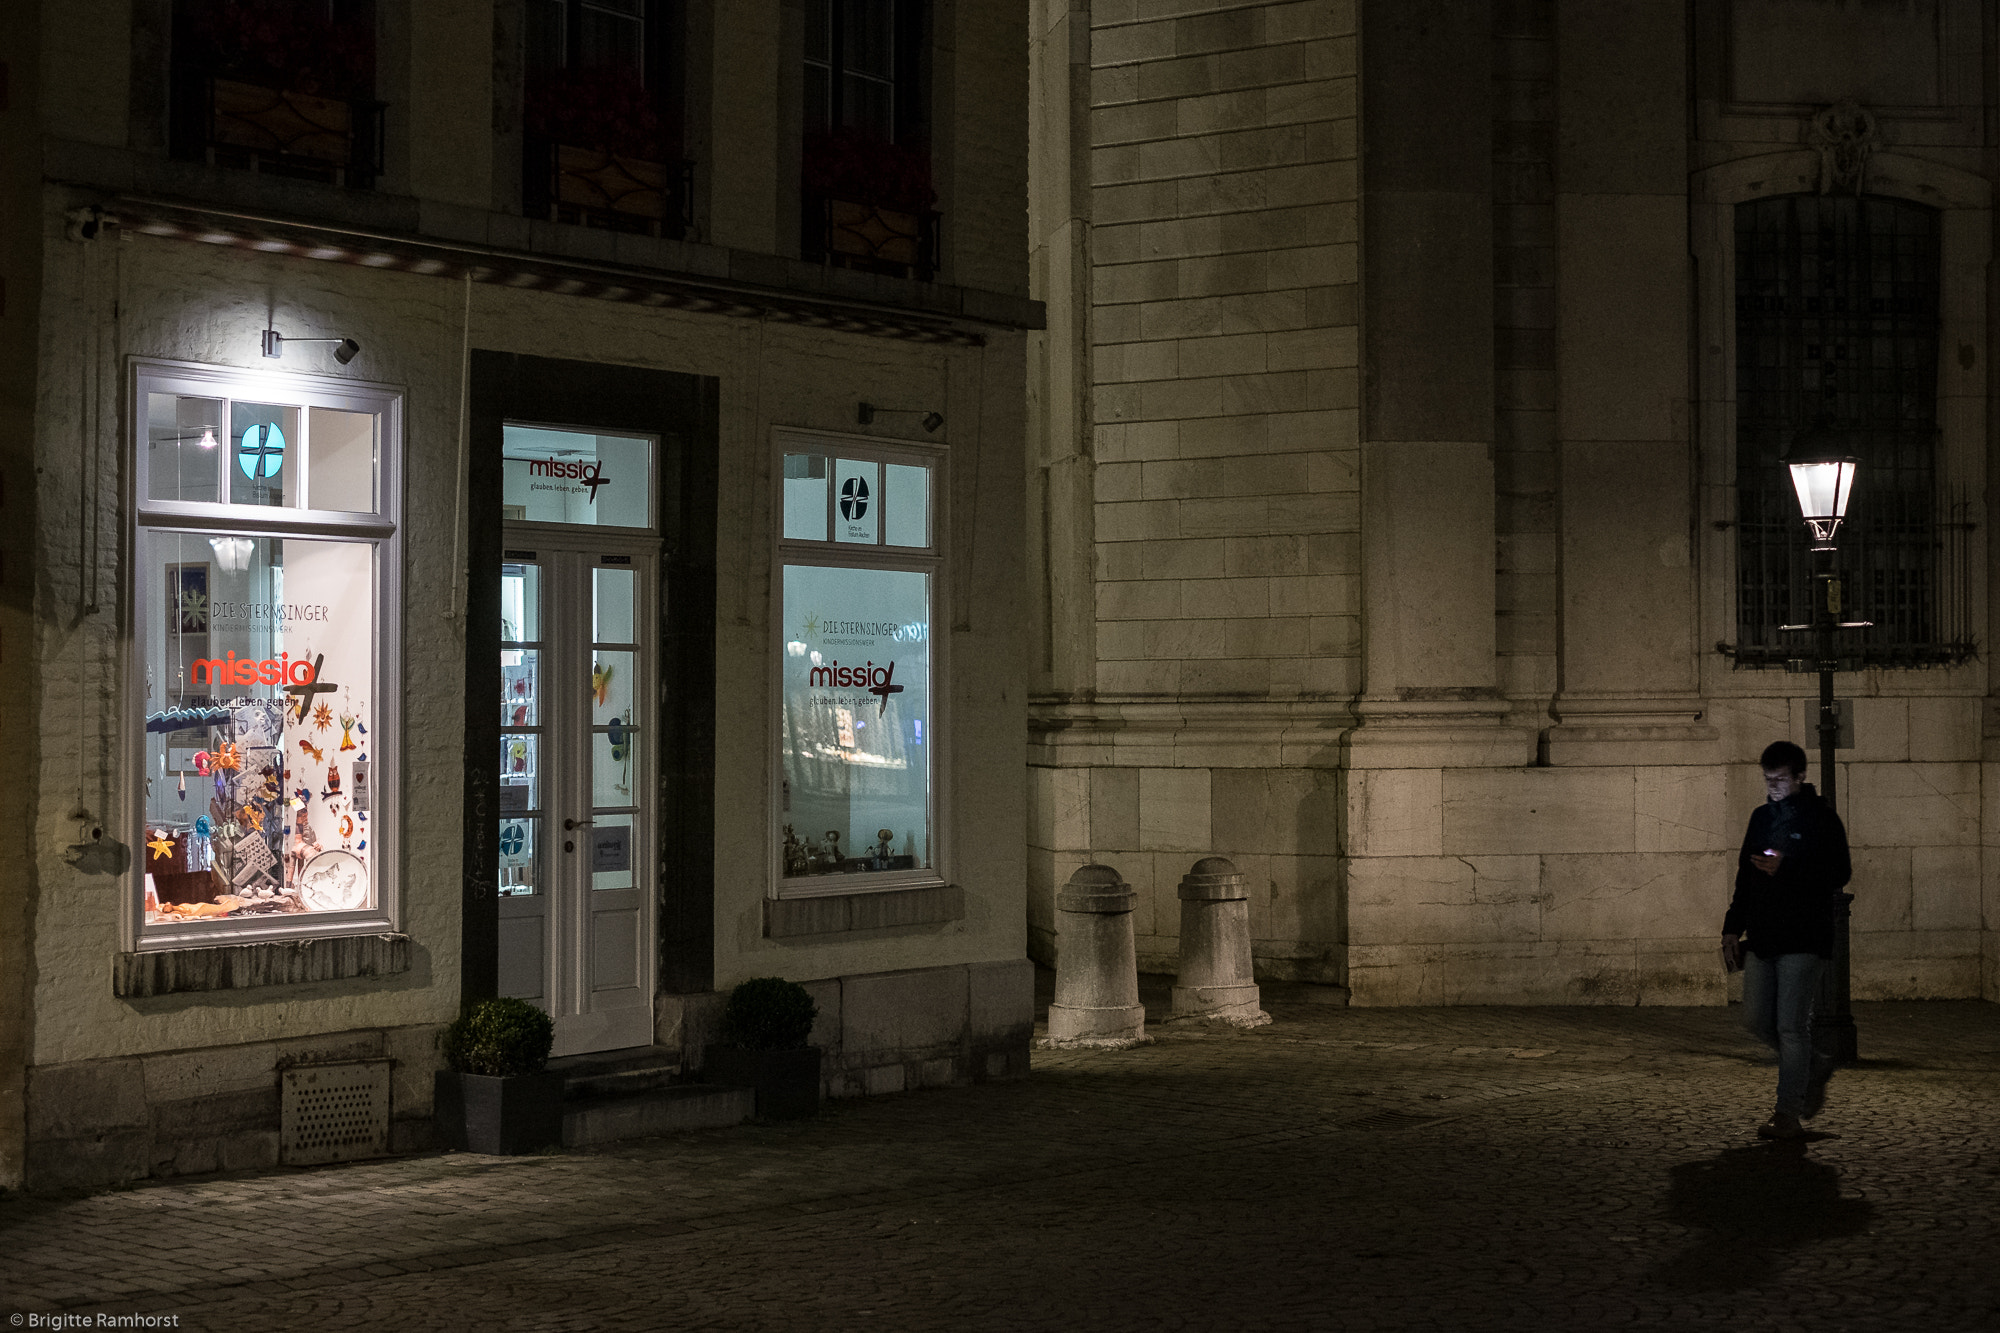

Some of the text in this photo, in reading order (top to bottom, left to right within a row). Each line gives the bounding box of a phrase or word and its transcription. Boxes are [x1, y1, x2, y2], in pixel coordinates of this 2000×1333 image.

[530, 456, 597, 480] missio
[213, 602, 329, 622] DIE STERNSINGER
[823, 620, 838, 634] DIE
[840, 621, 898, 637] STERNSINGER
[191, 650, 315, 686] missio
[809, 660, 890, 688] missio
